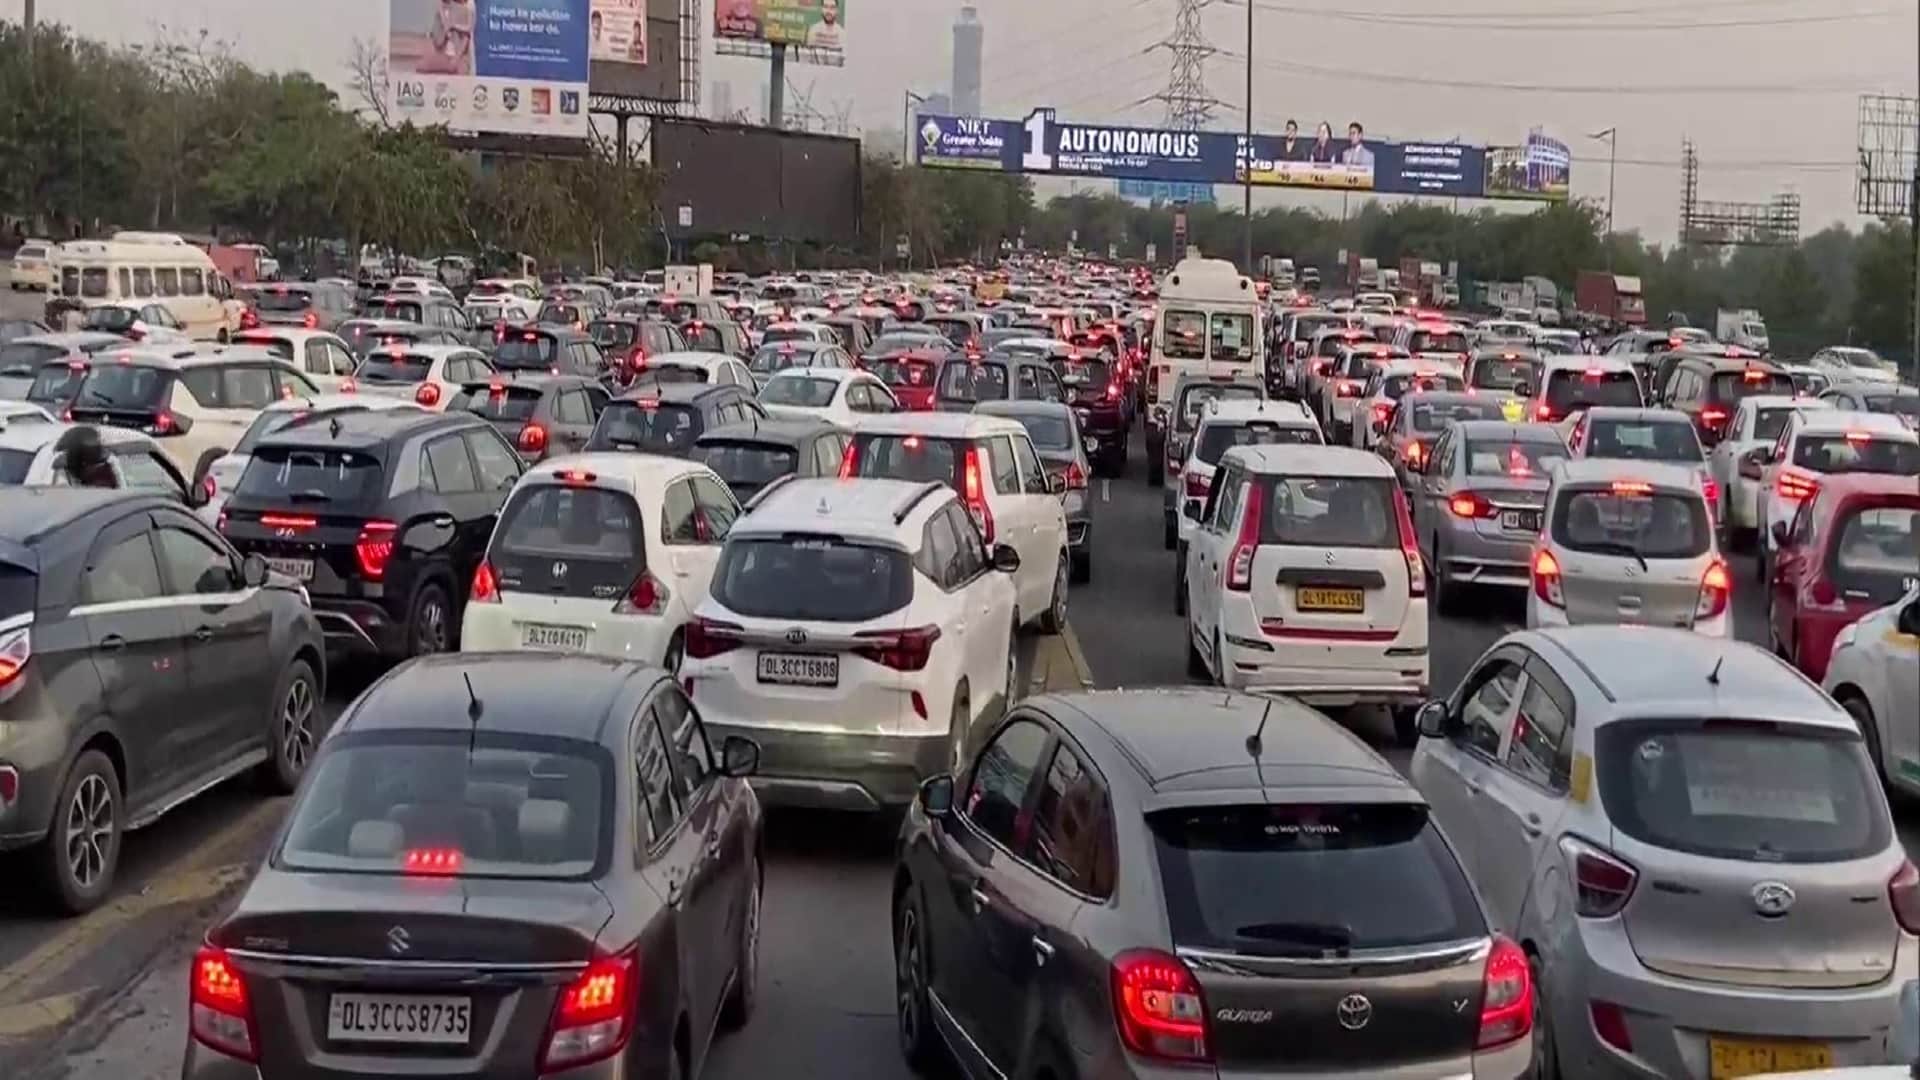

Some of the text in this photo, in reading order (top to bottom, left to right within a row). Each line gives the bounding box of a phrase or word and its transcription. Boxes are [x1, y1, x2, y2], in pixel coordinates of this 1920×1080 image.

[530, 9, 571, 22] pollution
[958, 119, 990, 135] NIET
[943, 133, 977, 146] Greater
[1059, 127, 1200, 157] AUTONOMOUS
[765, 657, 836, 678] DL3CCT6808
[342, 1001, 468, 1035] DL3CCS8735
